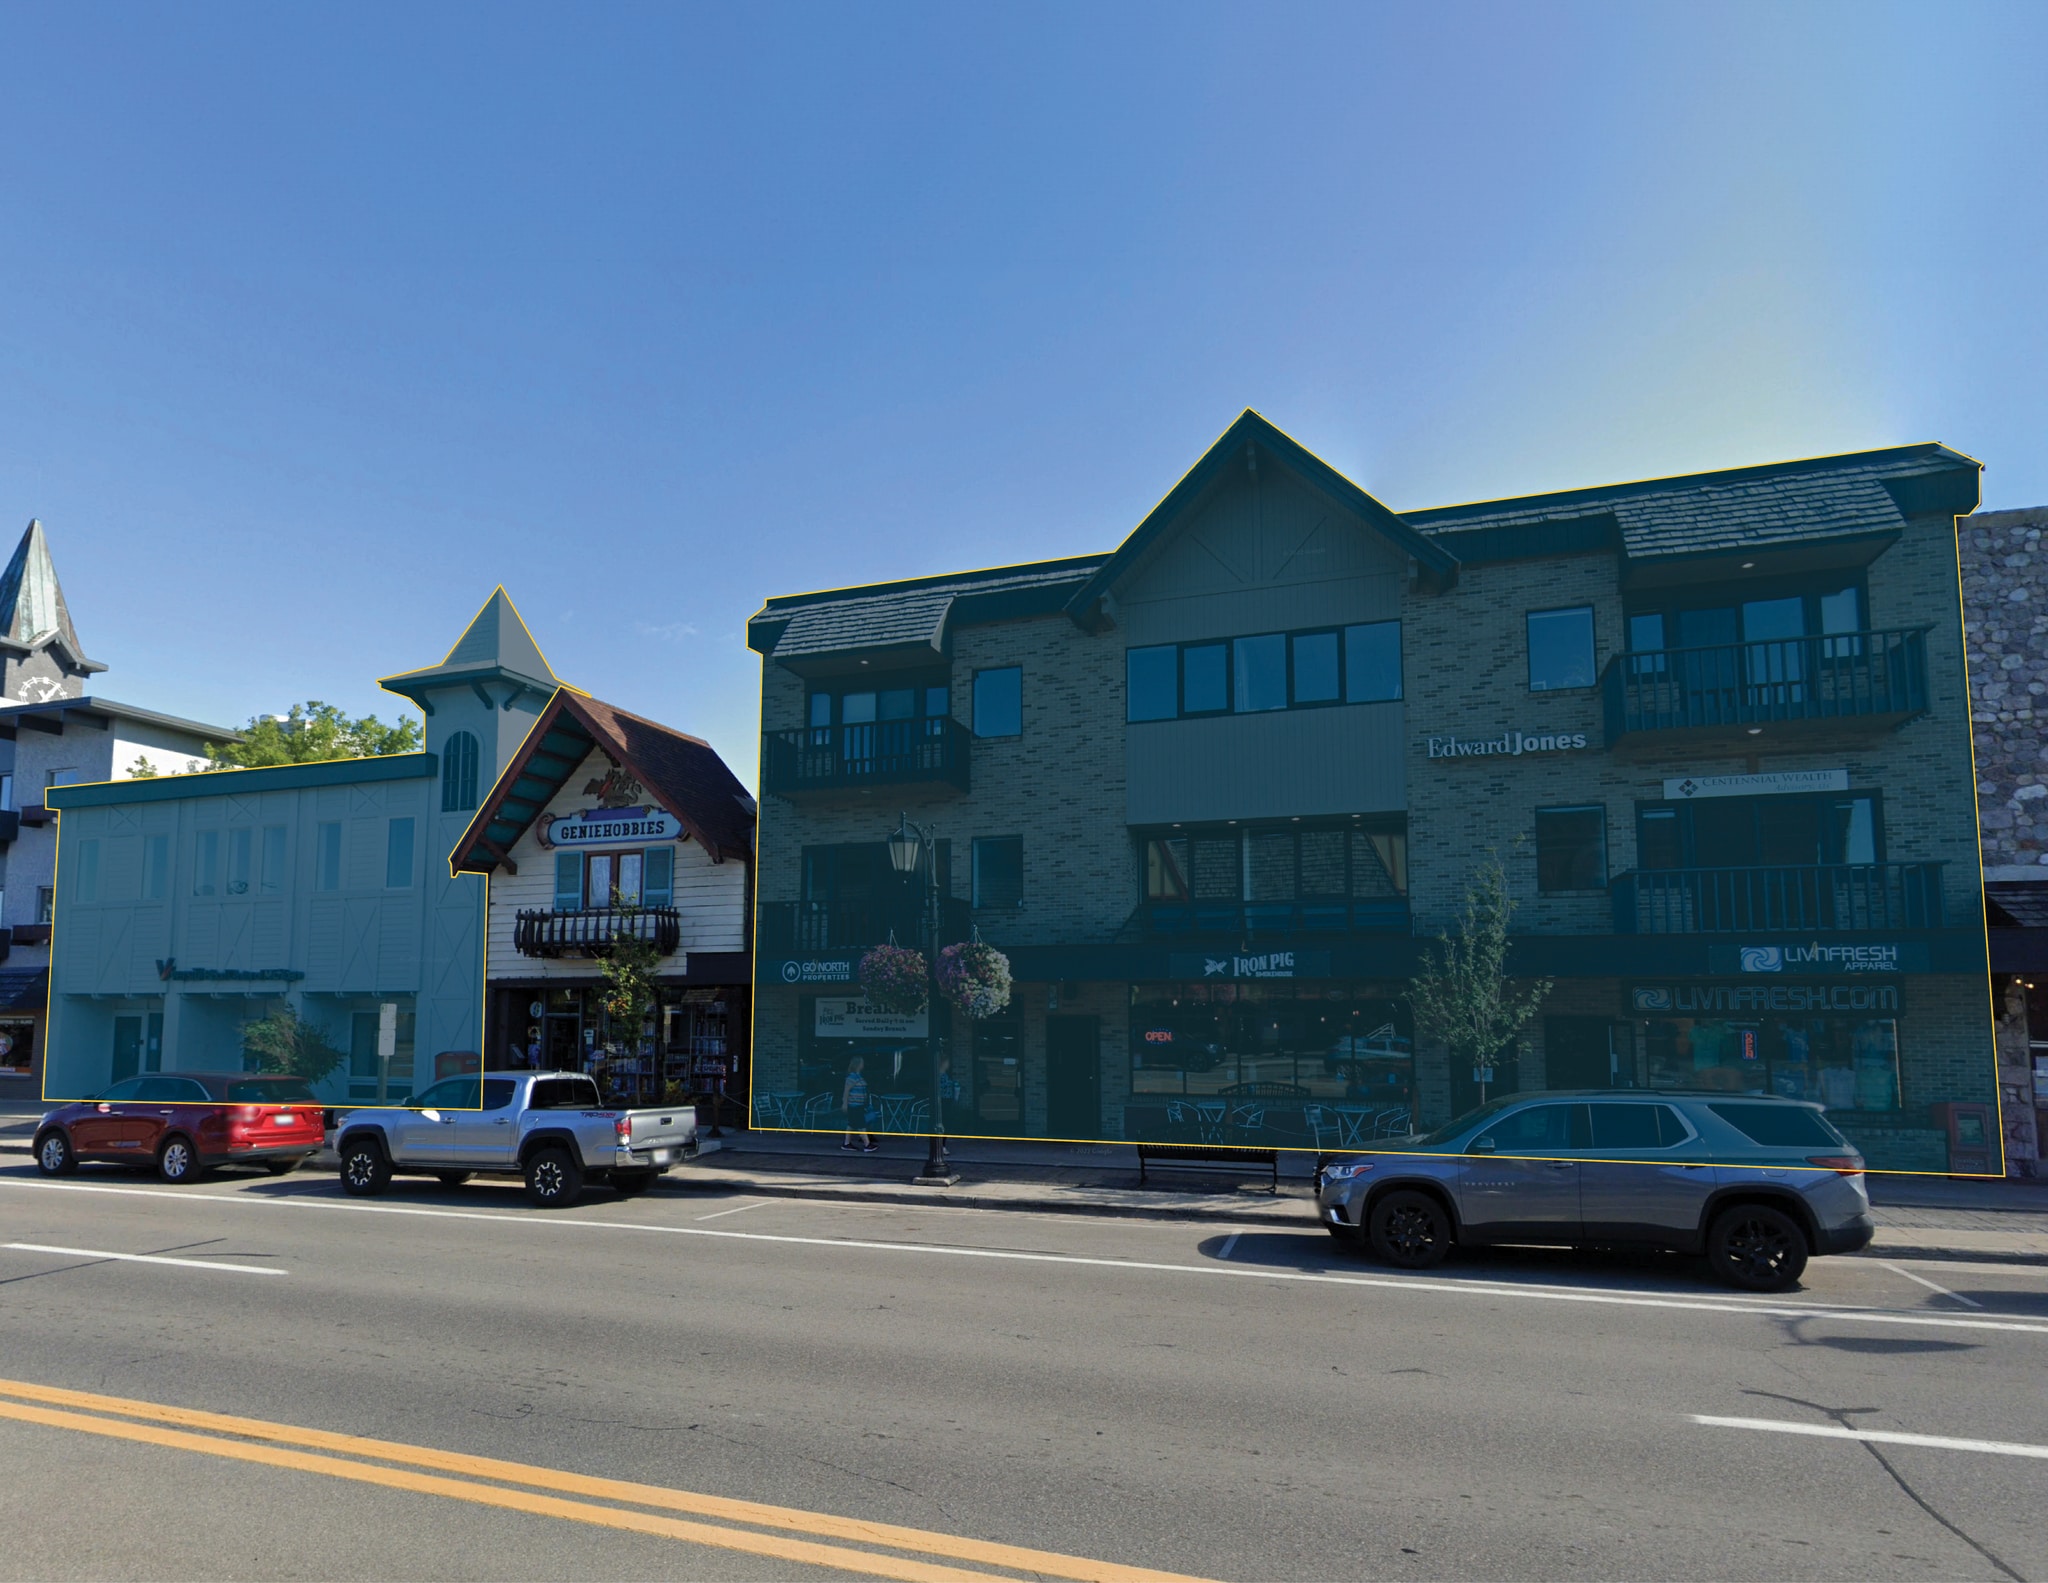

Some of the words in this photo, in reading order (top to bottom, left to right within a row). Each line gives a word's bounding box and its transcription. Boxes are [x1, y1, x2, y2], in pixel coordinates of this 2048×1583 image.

[1427, 732, 1511, 758] Edward
[1512, 731, 1587, 756] Jones
[1702, 776, 1777, 787] CENTENNIAL
[1782, 771, 1833, 782] WEALTH
[561, 820, 665, 840] GENIEHOBBIES
[802, 961, 817, 972] GO
[818, 961, 850, 972] NORTH
[1233, 955, 1268, 977] IRON
[1269, 952, 1295, 970] PIG
[1845, 961, 1898, 971] APPAREL
[802, 973, 851, 981] PROPERTIES
[1145, 1031, 1172, 1041] OPEN
